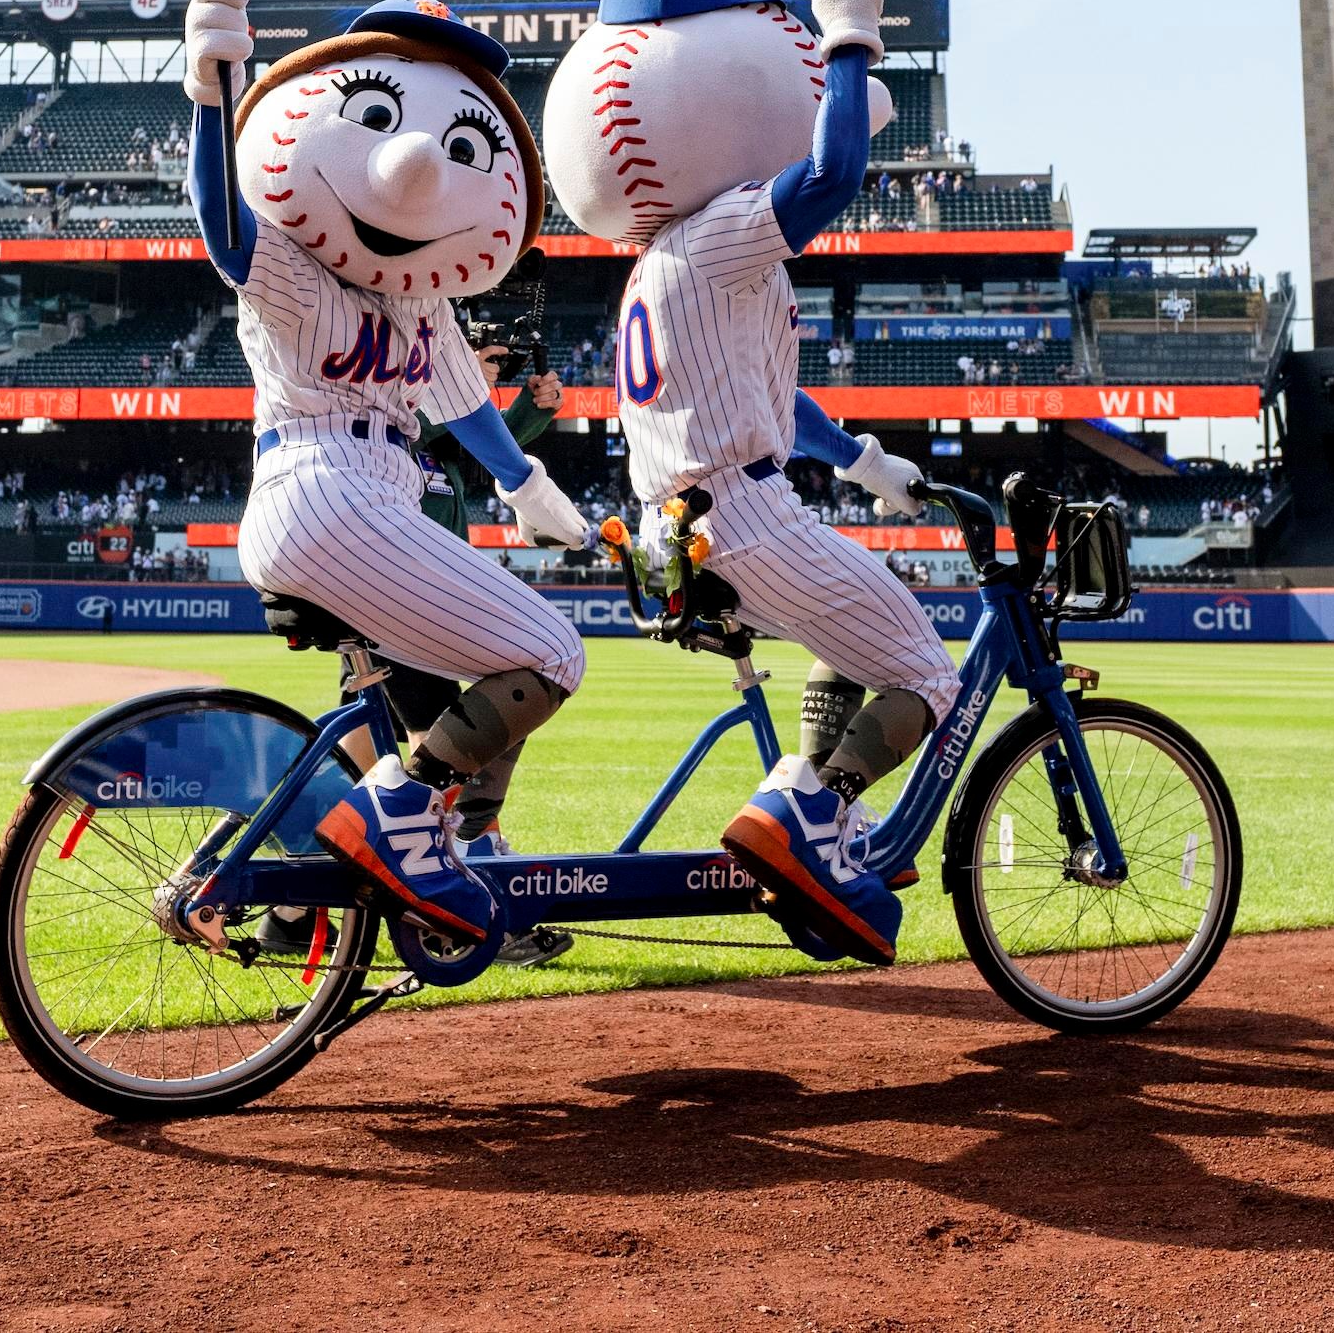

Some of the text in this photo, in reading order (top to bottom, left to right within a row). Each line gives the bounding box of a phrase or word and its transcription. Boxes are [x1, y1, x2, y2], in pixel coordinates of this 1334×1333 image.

[256, 28, 308, 38] moomoo
[504, 14, 539, 42] IN
[545, 12, 597, 42] TH
[877, 17, 911, 27] omoo
[146, 241, 193, 258] WIN
[811, 235, 860, 252] WIN
[901, 326, 924, 336] THE
[955, 326, 996, 336] PORCH
[1001, 326, 1025, 336] BAR
[321, 312, 435, 387] Met
[616, 296, 664, 408] 0
[111, 393, 181, 416] WIN
[575, 391, 620, 415] ME
[968, 390, 1175, 416] METS WIN
[67, 537, 128, 556] citi 22
[942, 560, 970, 571] DEC
[123, 599, 230, 618] HYUNDAI
[549, 599, 634, 625] EICO
[1193, 602, 1251, 631] citi
[802, 700, 843, 714] TATES
[803, 690, 844, 703] NITED
[801, 711, 837, 724] RMED
[938, 689, 987, 780] citi bike
[97, 774, 203, 800] citi bike
[509, 867, 608, 896] citi bike
[686, 865, 726, 890] citi
